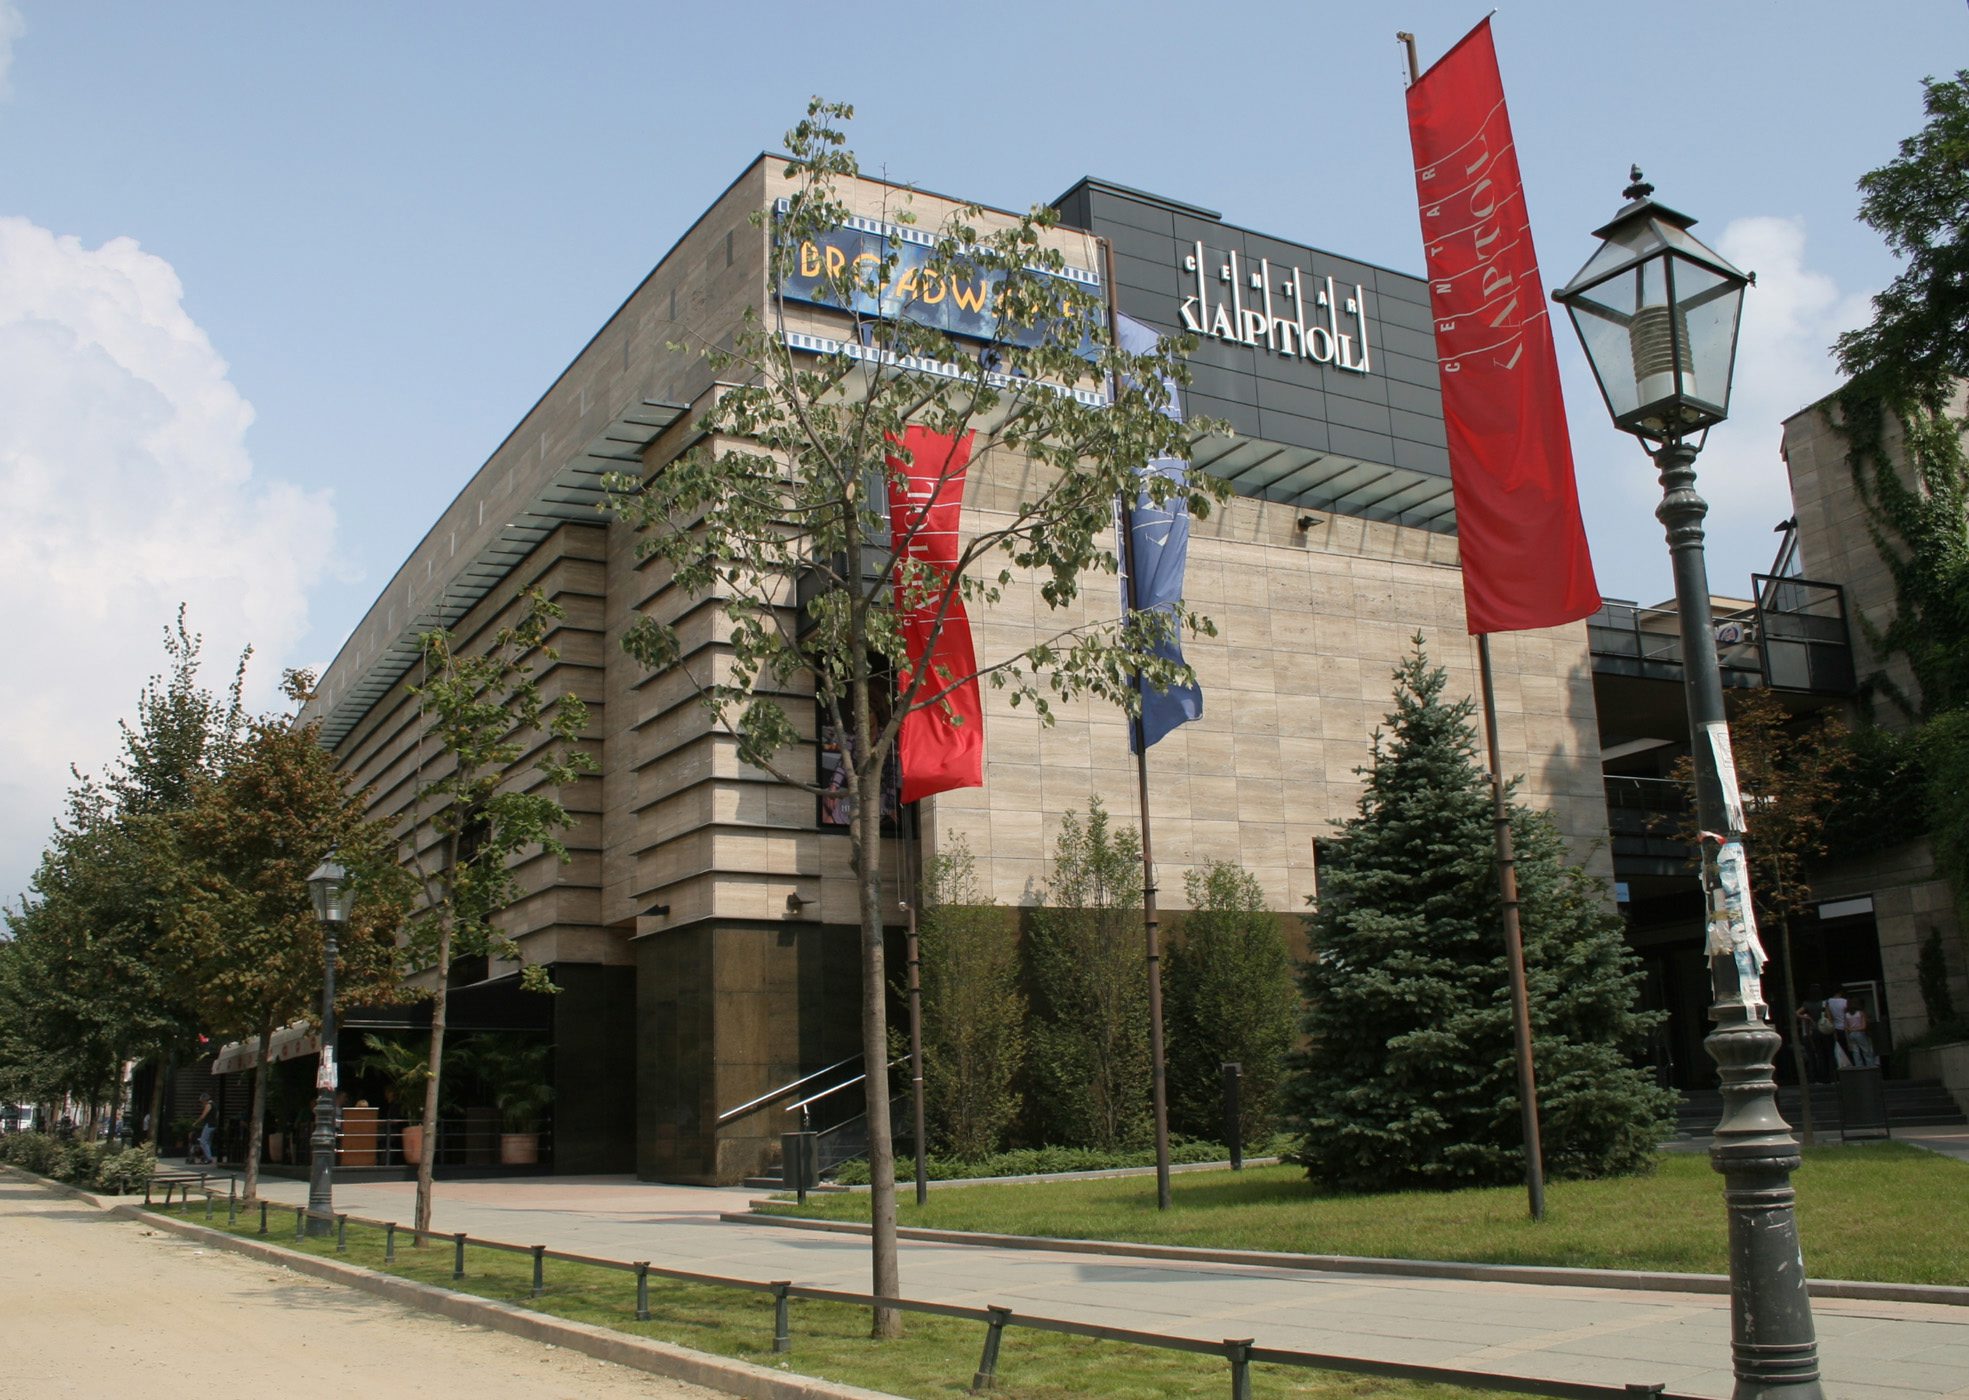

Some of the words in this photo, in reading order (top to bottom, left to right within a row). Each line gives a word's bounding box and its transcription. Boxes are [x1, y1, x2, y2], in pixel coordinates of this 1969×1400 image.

[800, 239, 1047, 326] BROADW
[1183, 255, 1358, 315] CENTAR
[1422, 166, 1461, 373] CENTAR
[1465, 133, 1523, 370] KAPTOL
[1179, 295, 1367, 373] KAPTOL
